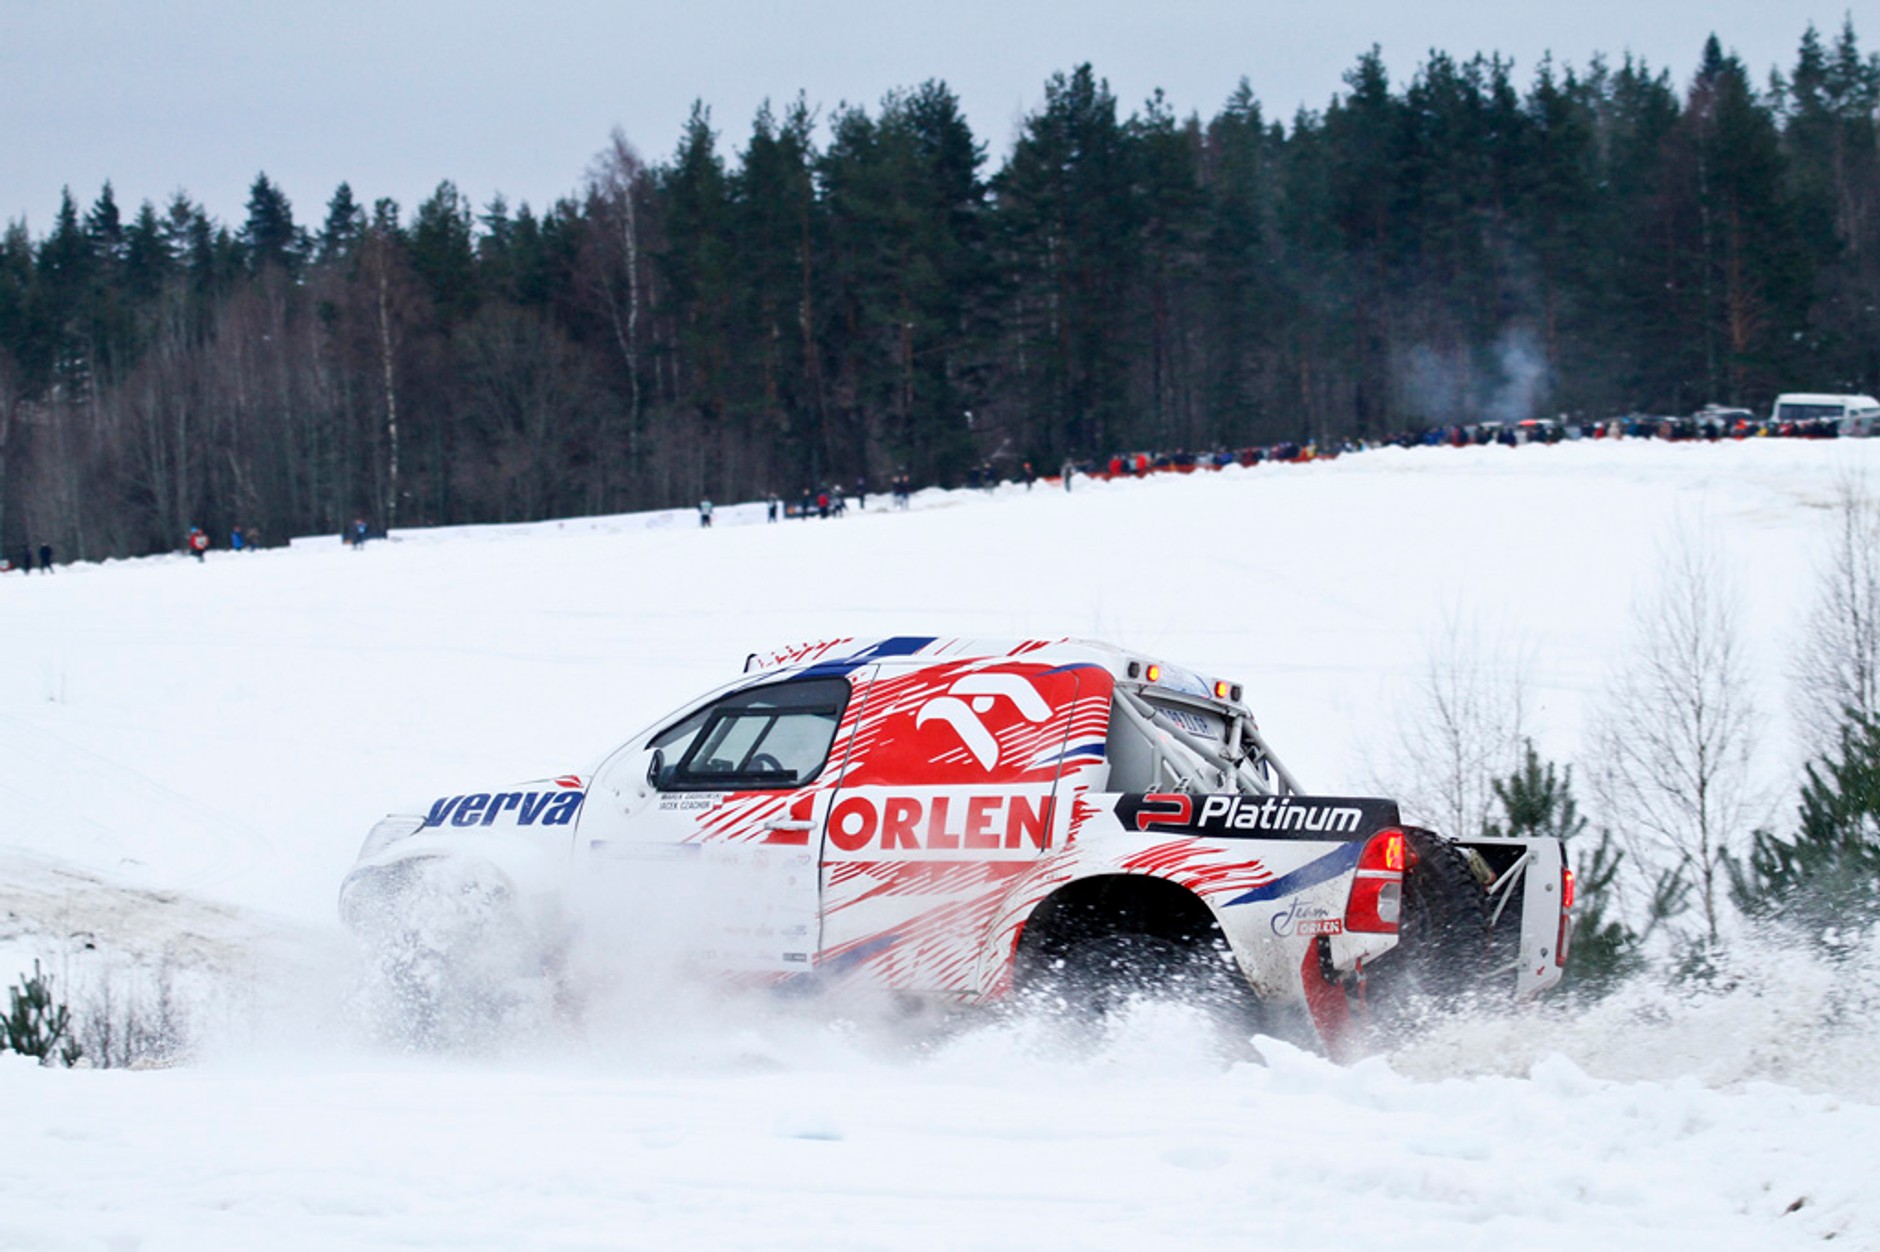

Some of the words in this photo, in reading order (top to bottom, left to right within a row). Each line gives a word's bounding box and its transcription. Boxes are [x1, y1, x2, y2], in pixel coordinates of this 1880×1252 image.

[426, 791, 584, 827] verva
[828, 796, 1057, 851] ORLEN
[1198, 796, 1362, 832] Platinum
[1300, 920, 1340, 934] ORLEN
